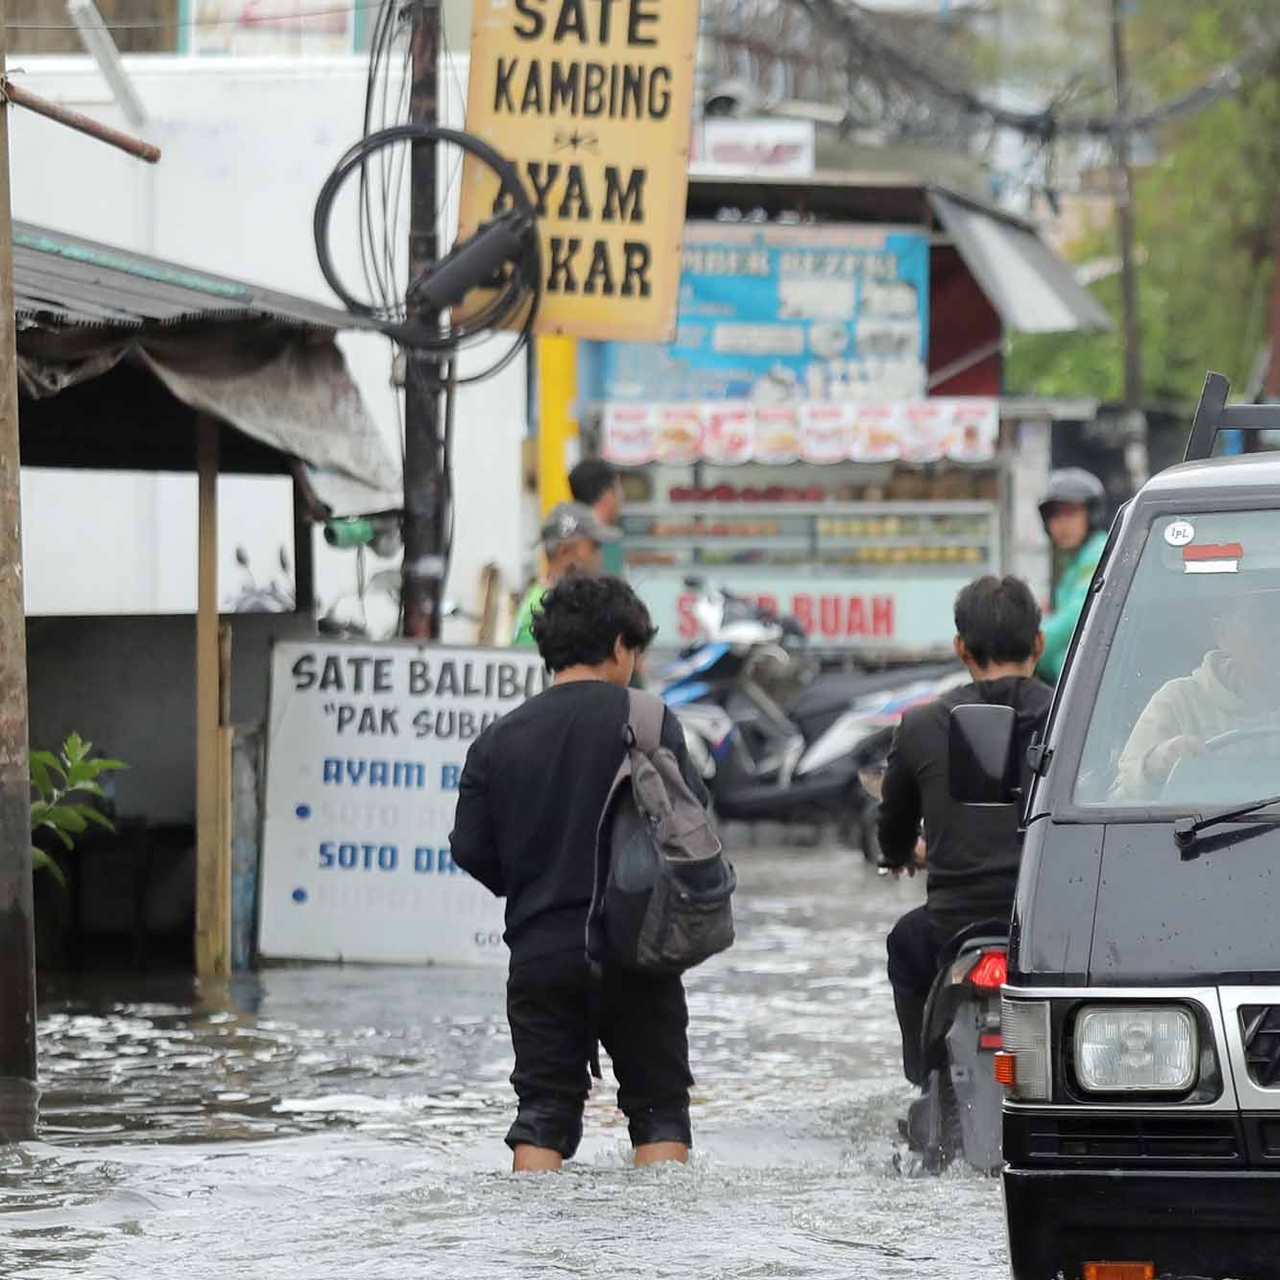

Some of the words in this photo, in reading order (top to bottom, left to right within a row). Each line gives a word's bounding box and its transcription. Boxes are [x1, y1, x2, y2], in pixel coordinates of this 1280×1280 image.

[513, 0, 660, 47] SATE
[493, 57, 673, 119] KAMBING
[792, 593, 896, 638] BUAH
[292, 655, 394, 694] SATE
[409, 660, 553, 700] BALIBU
[318, 842, 400, 872] SOTO
